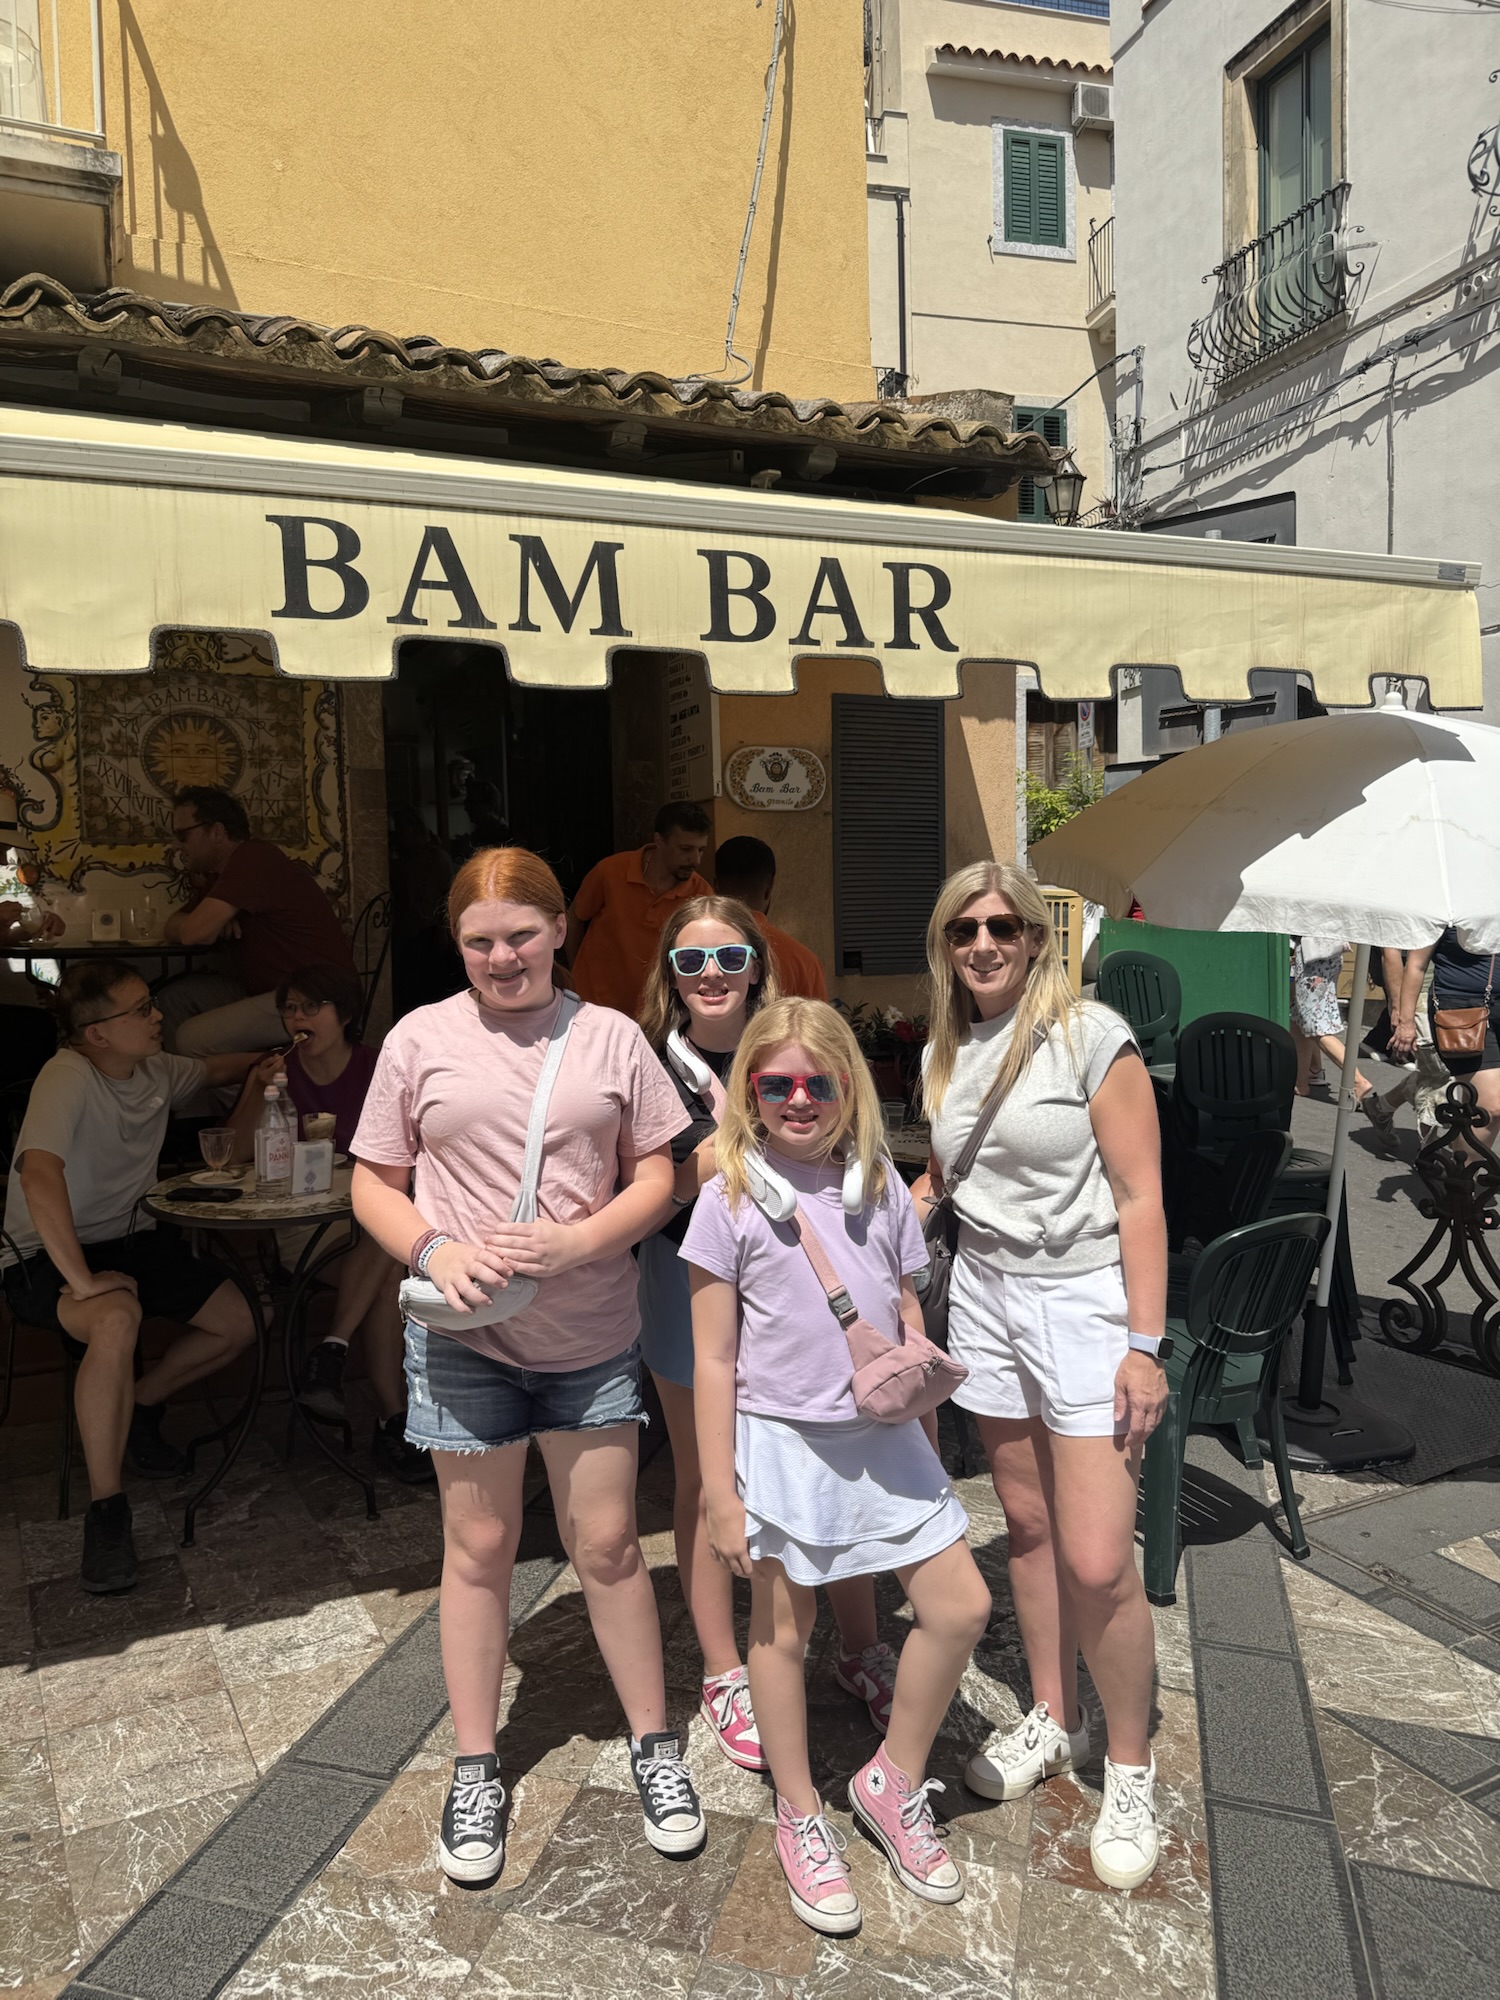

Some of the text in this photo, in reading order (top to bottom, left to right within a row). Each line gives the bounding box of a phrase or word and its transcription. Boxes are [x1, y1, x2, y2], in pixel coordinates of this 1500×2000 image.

[266, 515, 959, 651] BAM BAR
[148, 687, 235, 714] BAM-BAR
[749, 782, 801, 794] Bam Bar
[269, 1152, 290, 1162] PANN
